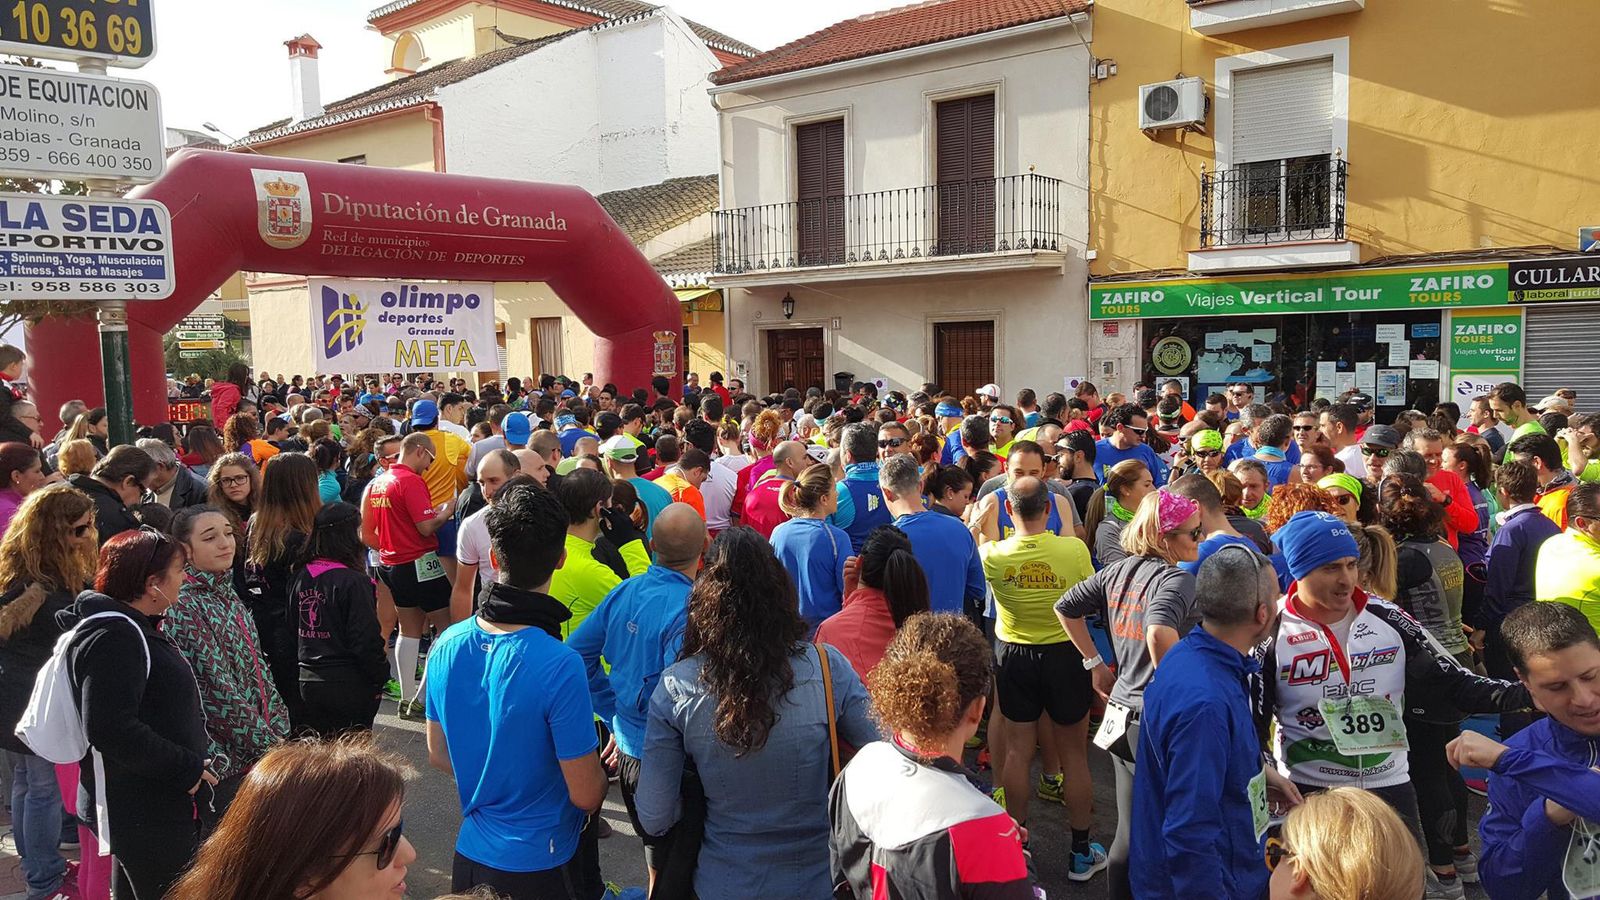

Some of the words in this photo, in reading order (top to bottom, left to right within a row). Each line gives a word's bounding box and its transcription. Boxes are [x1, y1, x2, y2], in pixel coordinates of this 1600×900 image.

[12, 1, 50, 43] 10
[60, 7, 97, 49] 36
[106, 14, 142, 55] 69
[28, 78, 148, 111] EQUITACION
[1, 106, 64, 127] Molino,
[70, 114, 95, 127] s/n
[0, 128, 51, 144] abias
[69, 133, 141, 151] Granada
[48, 151, 80, 166] 666
[86, 154, 117, 168] 400
[122, 156, 152, 171] 350
[1, 201, 49, 231] LA
[62, 204, 162, 235] SEDA
[321, 192, 451, 223] Diputación
[456, 204, 480, 225] de
[483, 206, 567, 231] Granada
[323, 230, 347, 242] Red
[351, 232, 365, 243] de
[368, 235, 430, 249] municipios
[11, 252, 62, 265] Spinning,
[66, 254, 95, 266] Yoga,
[98, 255, 163, 265] Musculación
[428, 250, 448, 262] DE
[454, 252, 526, 265] DEPORTES
[11, 265, 55, 277] Fitness,
[58, 266, 82, 276] Sala
[84, 267, 98, 276] de
[101, 267, 143, 278] Masajes
[1514, 266, 1600, 286] CULLAR
[31, 281, 71, 292] 958
[79, 282, 116, 292] 586
[124, 283, 160, 293] 303
[1409, 274, 1494, 292] ZAFIRO
[380, 285, 481, 314] olimpo
[1101, 290, 1165, 305] ZAFIRO
[1186, 293, 1235, 309] Viajes
[1240, 288, 1323, 304] Vertical
[1331, 286, 1382, 301] Tour
[1409, 291, 1462, 303] TOURS
[378, 311, 443, 326] deportes
[1101, 304, 1141, 315] TOURS
[408, 327, 455, 336] Granada
[1454, 324, 1517, 335] ZAFIRO
[1454, 335, 1493, 343] TOURS
[394, 340, 477, 368] META
[1454, 348, 1477, 356] Viajes
[1480, 347, 1516, 355] Vertical
[1020, 572, 1054, 583] PILLÍN
[1341, 713, 1385, 735] 389
